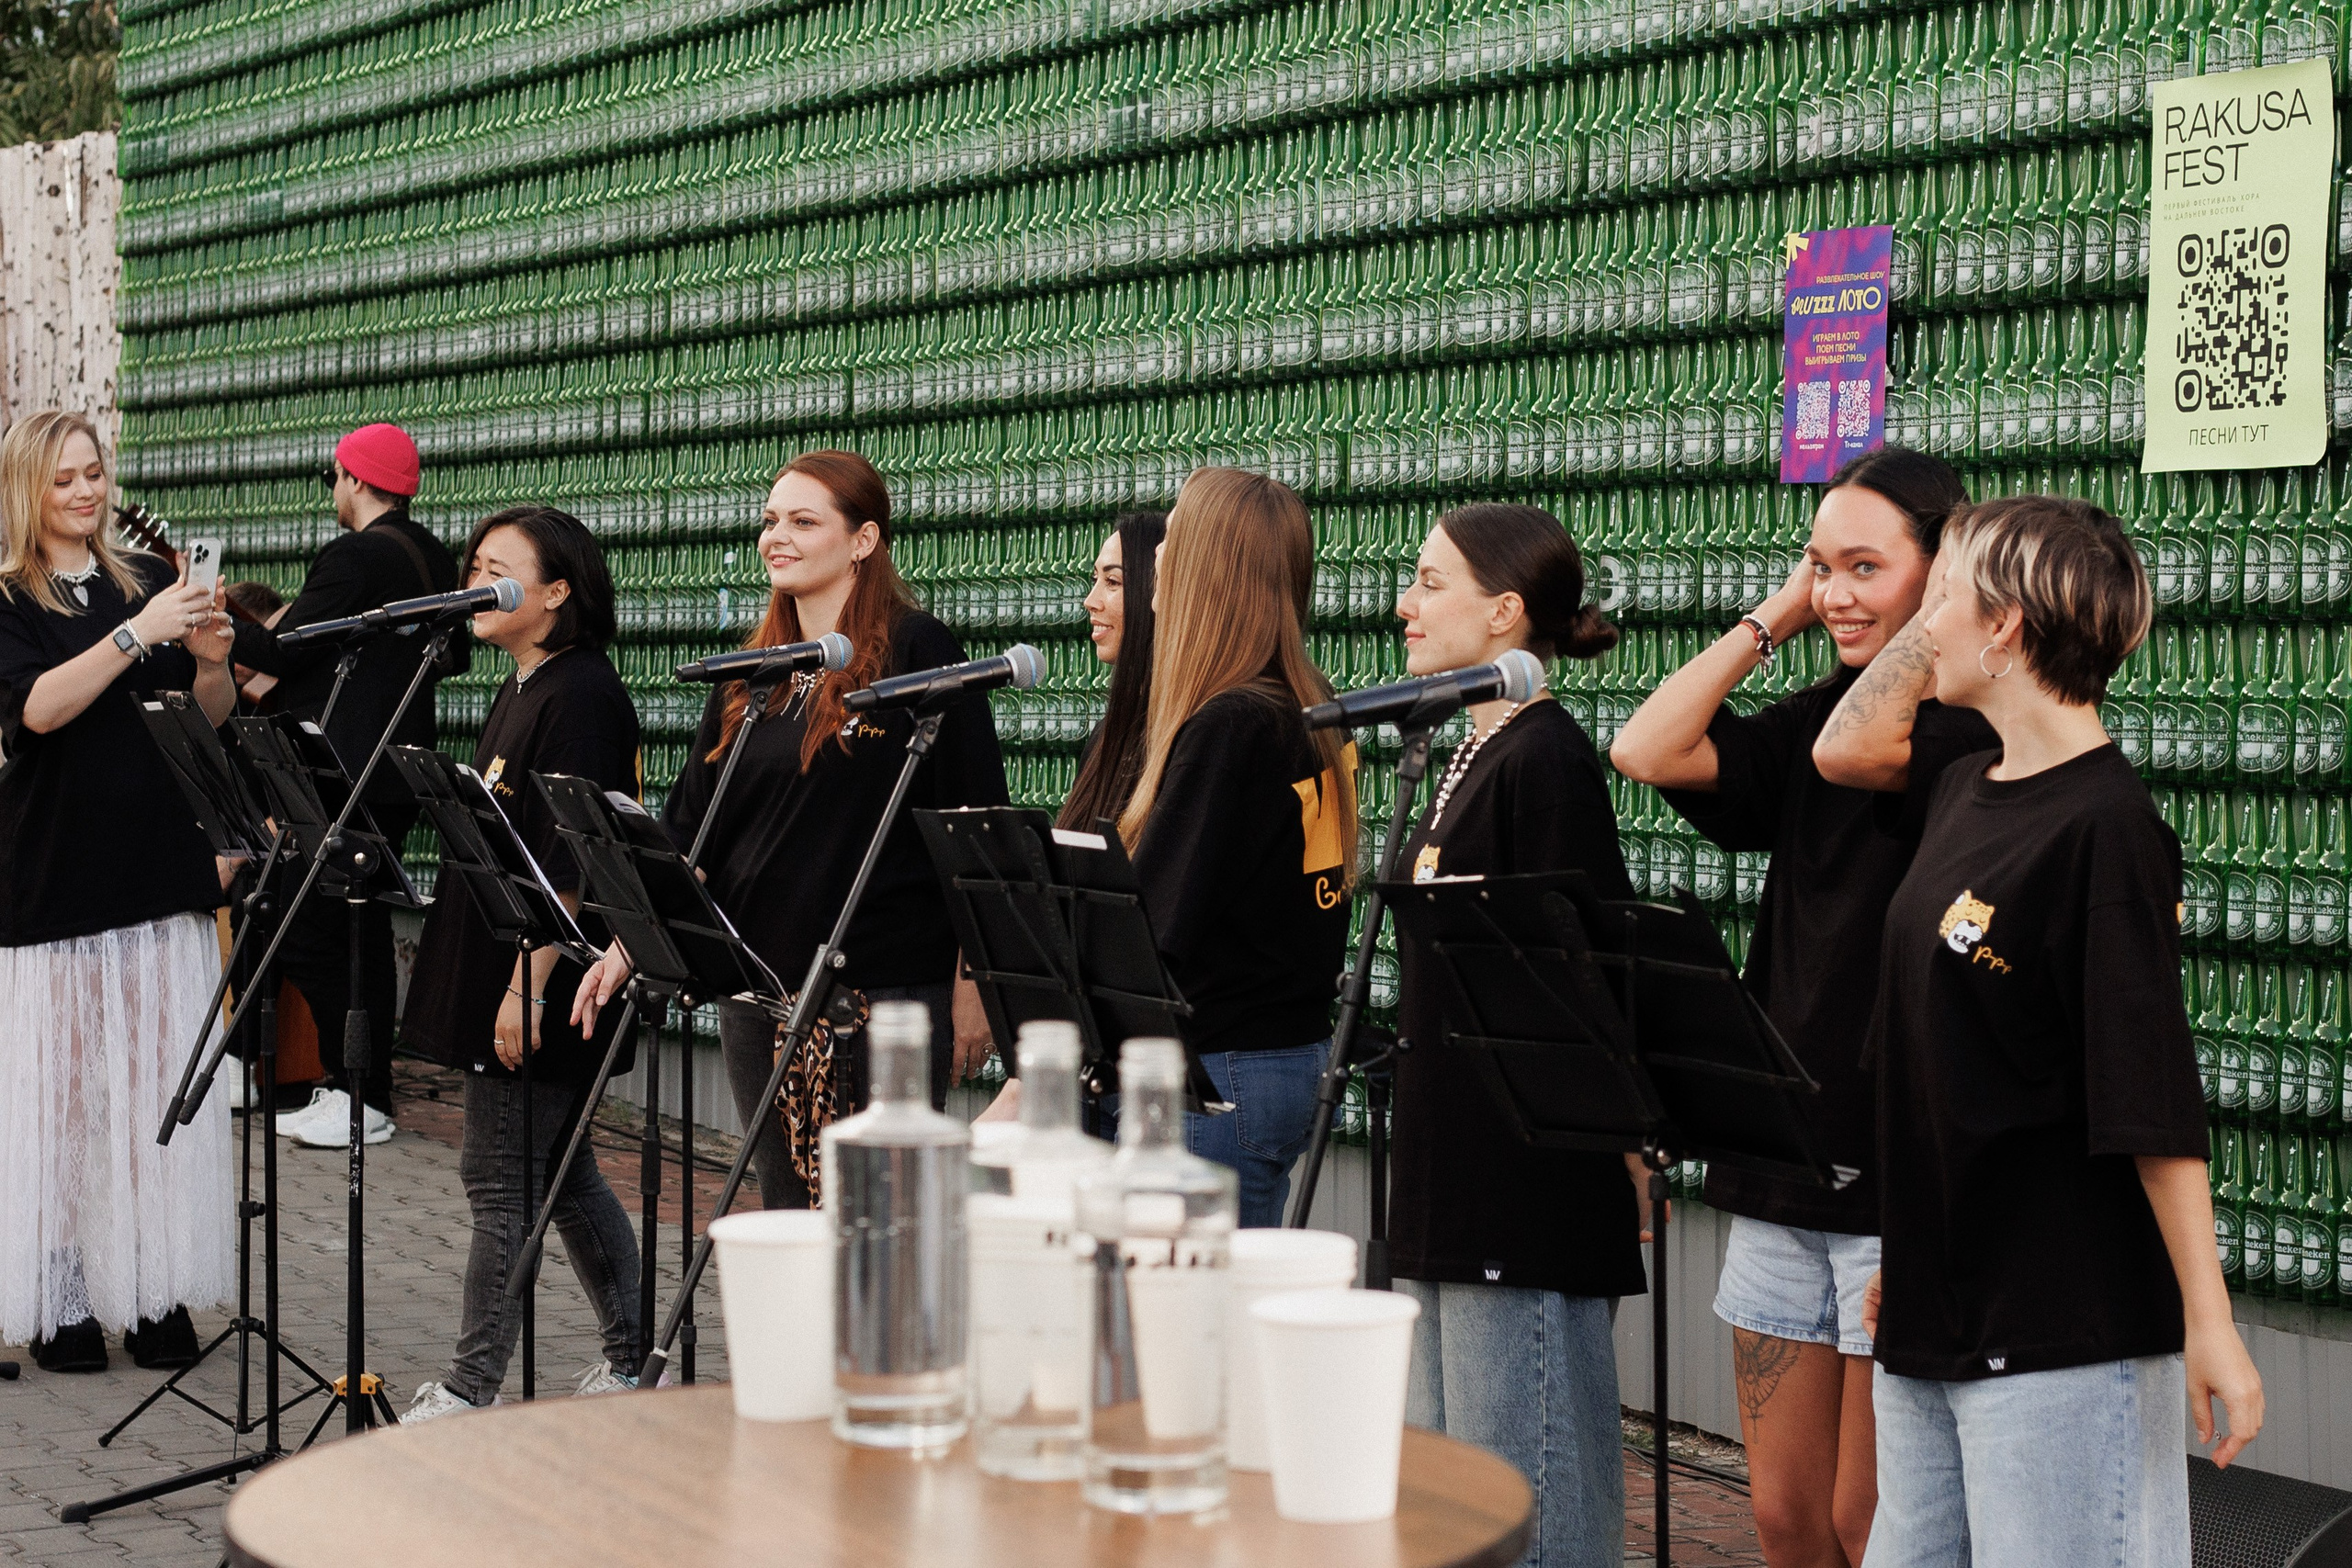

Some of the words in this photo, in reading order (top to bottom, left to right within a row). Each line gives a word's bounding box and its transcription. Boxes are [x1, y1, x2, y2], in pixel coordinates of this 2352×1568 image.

[2165, 87, 2312, 145] RAKUSA
[2164, 141, 2250, 191] FEST
[2164, 199, 2191, 211] ПЕРВЫЙ
[2193, 195, 2237, 207] ФЕСТИВАЛЬ
[2240, 192, 2261, 202] ХОРА
[2175, 209, 2208, 221] ДАЛЬНЕМ
[2210, 205, 2245, 217] ВОСТОКЕ
[1815, 273, 1870, 285] РАЗВЛЕКАТЕЛЬНОЕ
[1870, 270, 1885, 280] ШОУ
[1838, 286, 1882, 312] ЛОТО
[1813, 333, 1837, 343] ИГРАЕМ
[1842, 331, 1860, 340] ЛОТО
[1815, 344, 1835, 354] ПОЕМ
[1835, 342, 1857, 352] ПЕСНИ
[1804, 355, 1846, 366] ВЫИГРЫВАЕМ
[1846, 353, 1867, 363] ПРИЗЫ
[2188, 426, 2238, 446] ПЕСНИ
[2242, 423, 2269, 443] ТУТ
